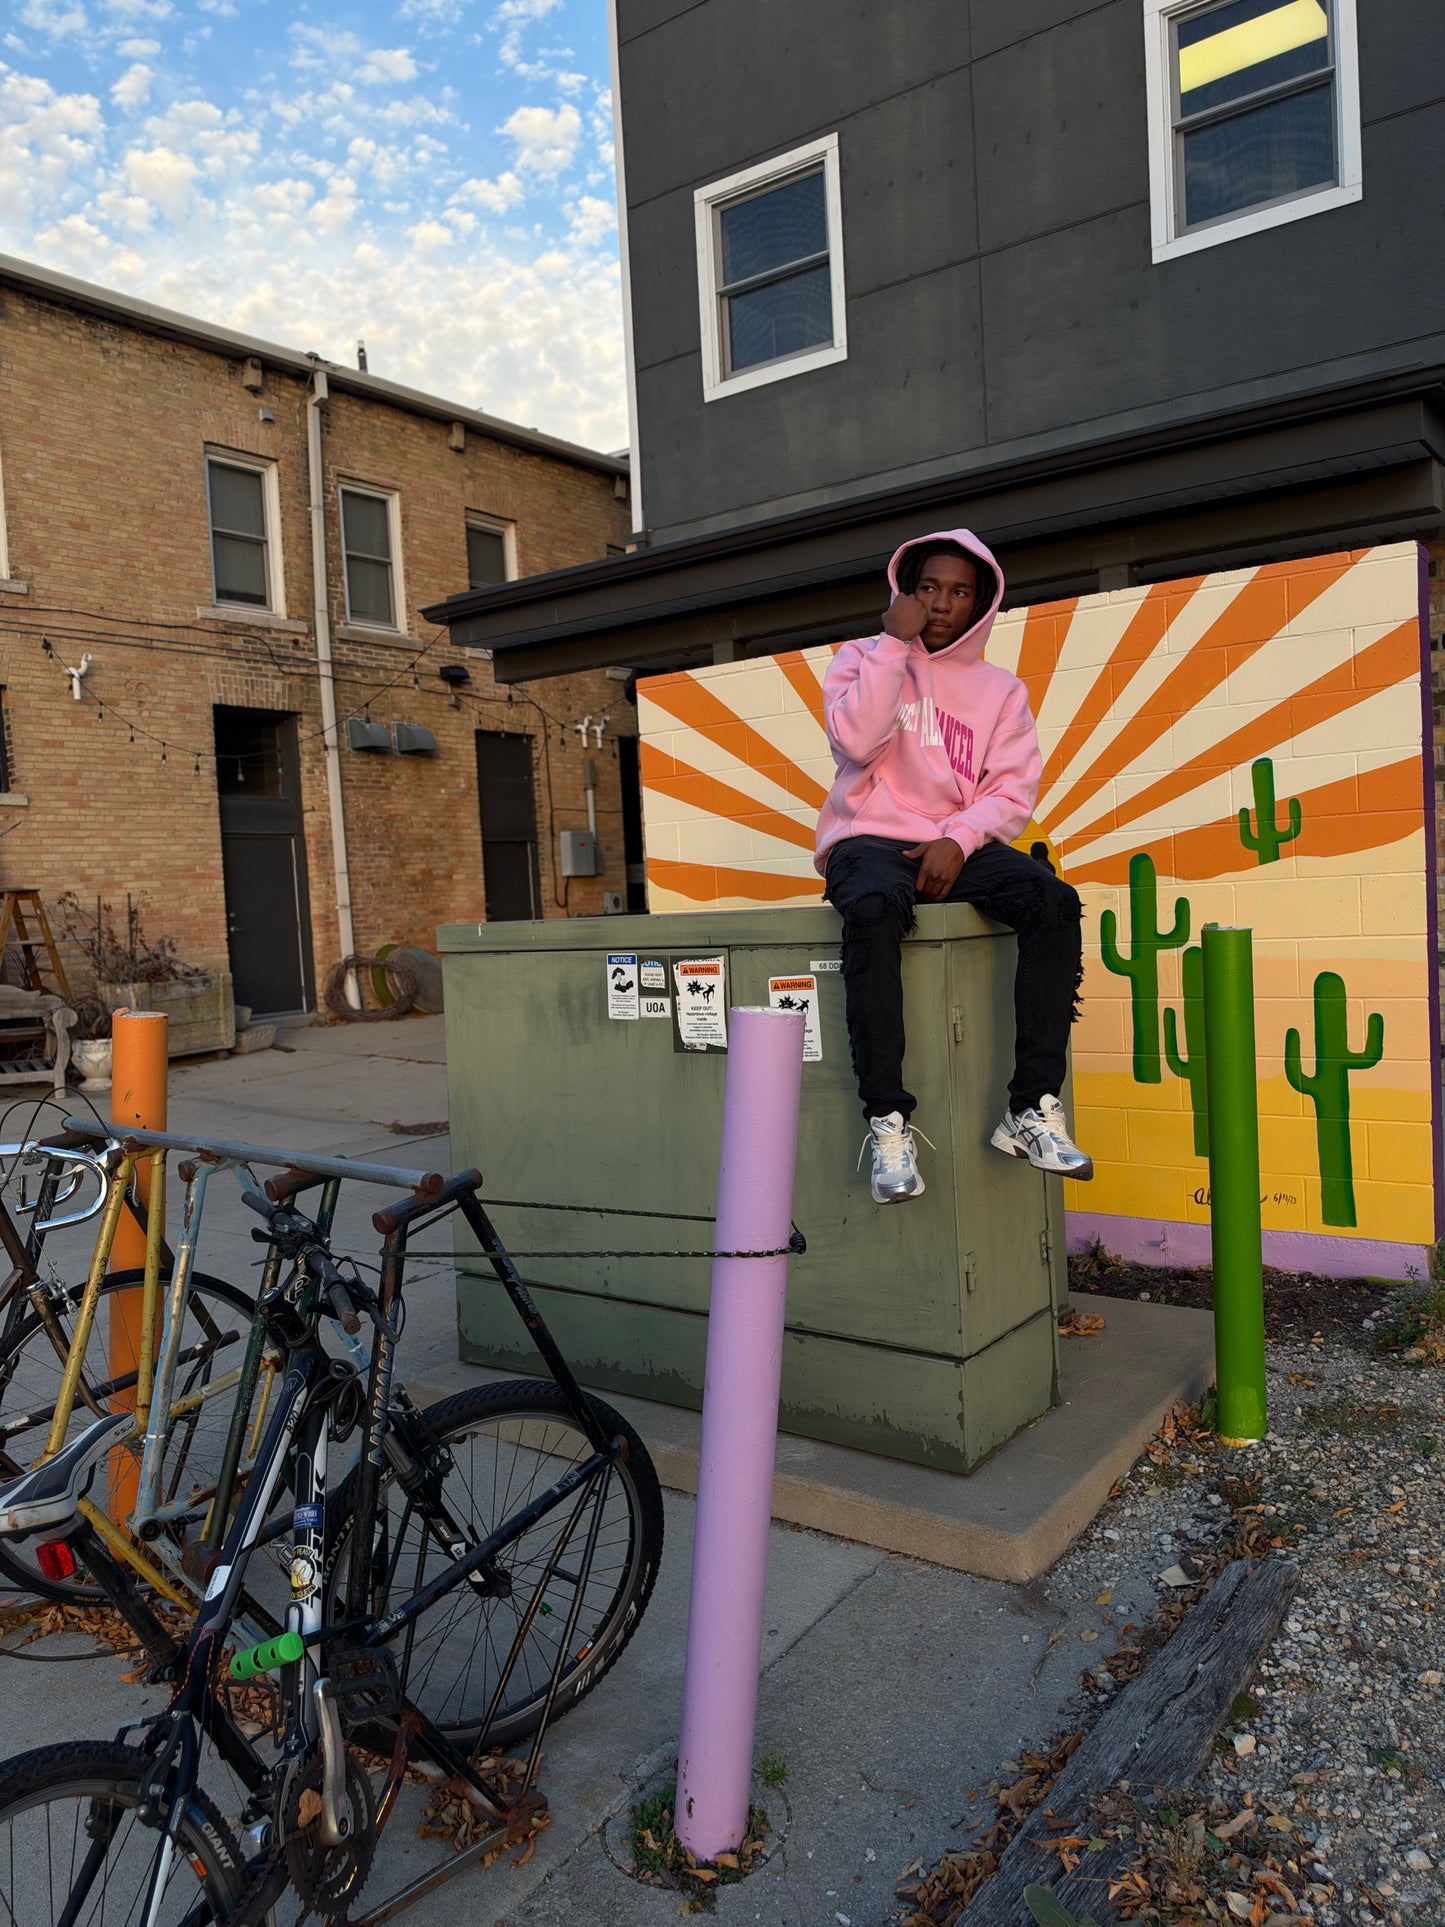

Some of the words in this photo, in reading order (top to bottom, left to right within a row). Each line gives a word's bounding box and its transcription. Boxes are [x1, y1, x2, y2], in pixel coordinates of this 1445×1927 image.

[611, 956, 633, 964] NOTICE
[689, 966, 718, 974] WARNING
[780, 981, 812, 990] WARNING
[646, 1002, 666, 1013] UOA
[201, 1822, 235, 1869] GIANT
